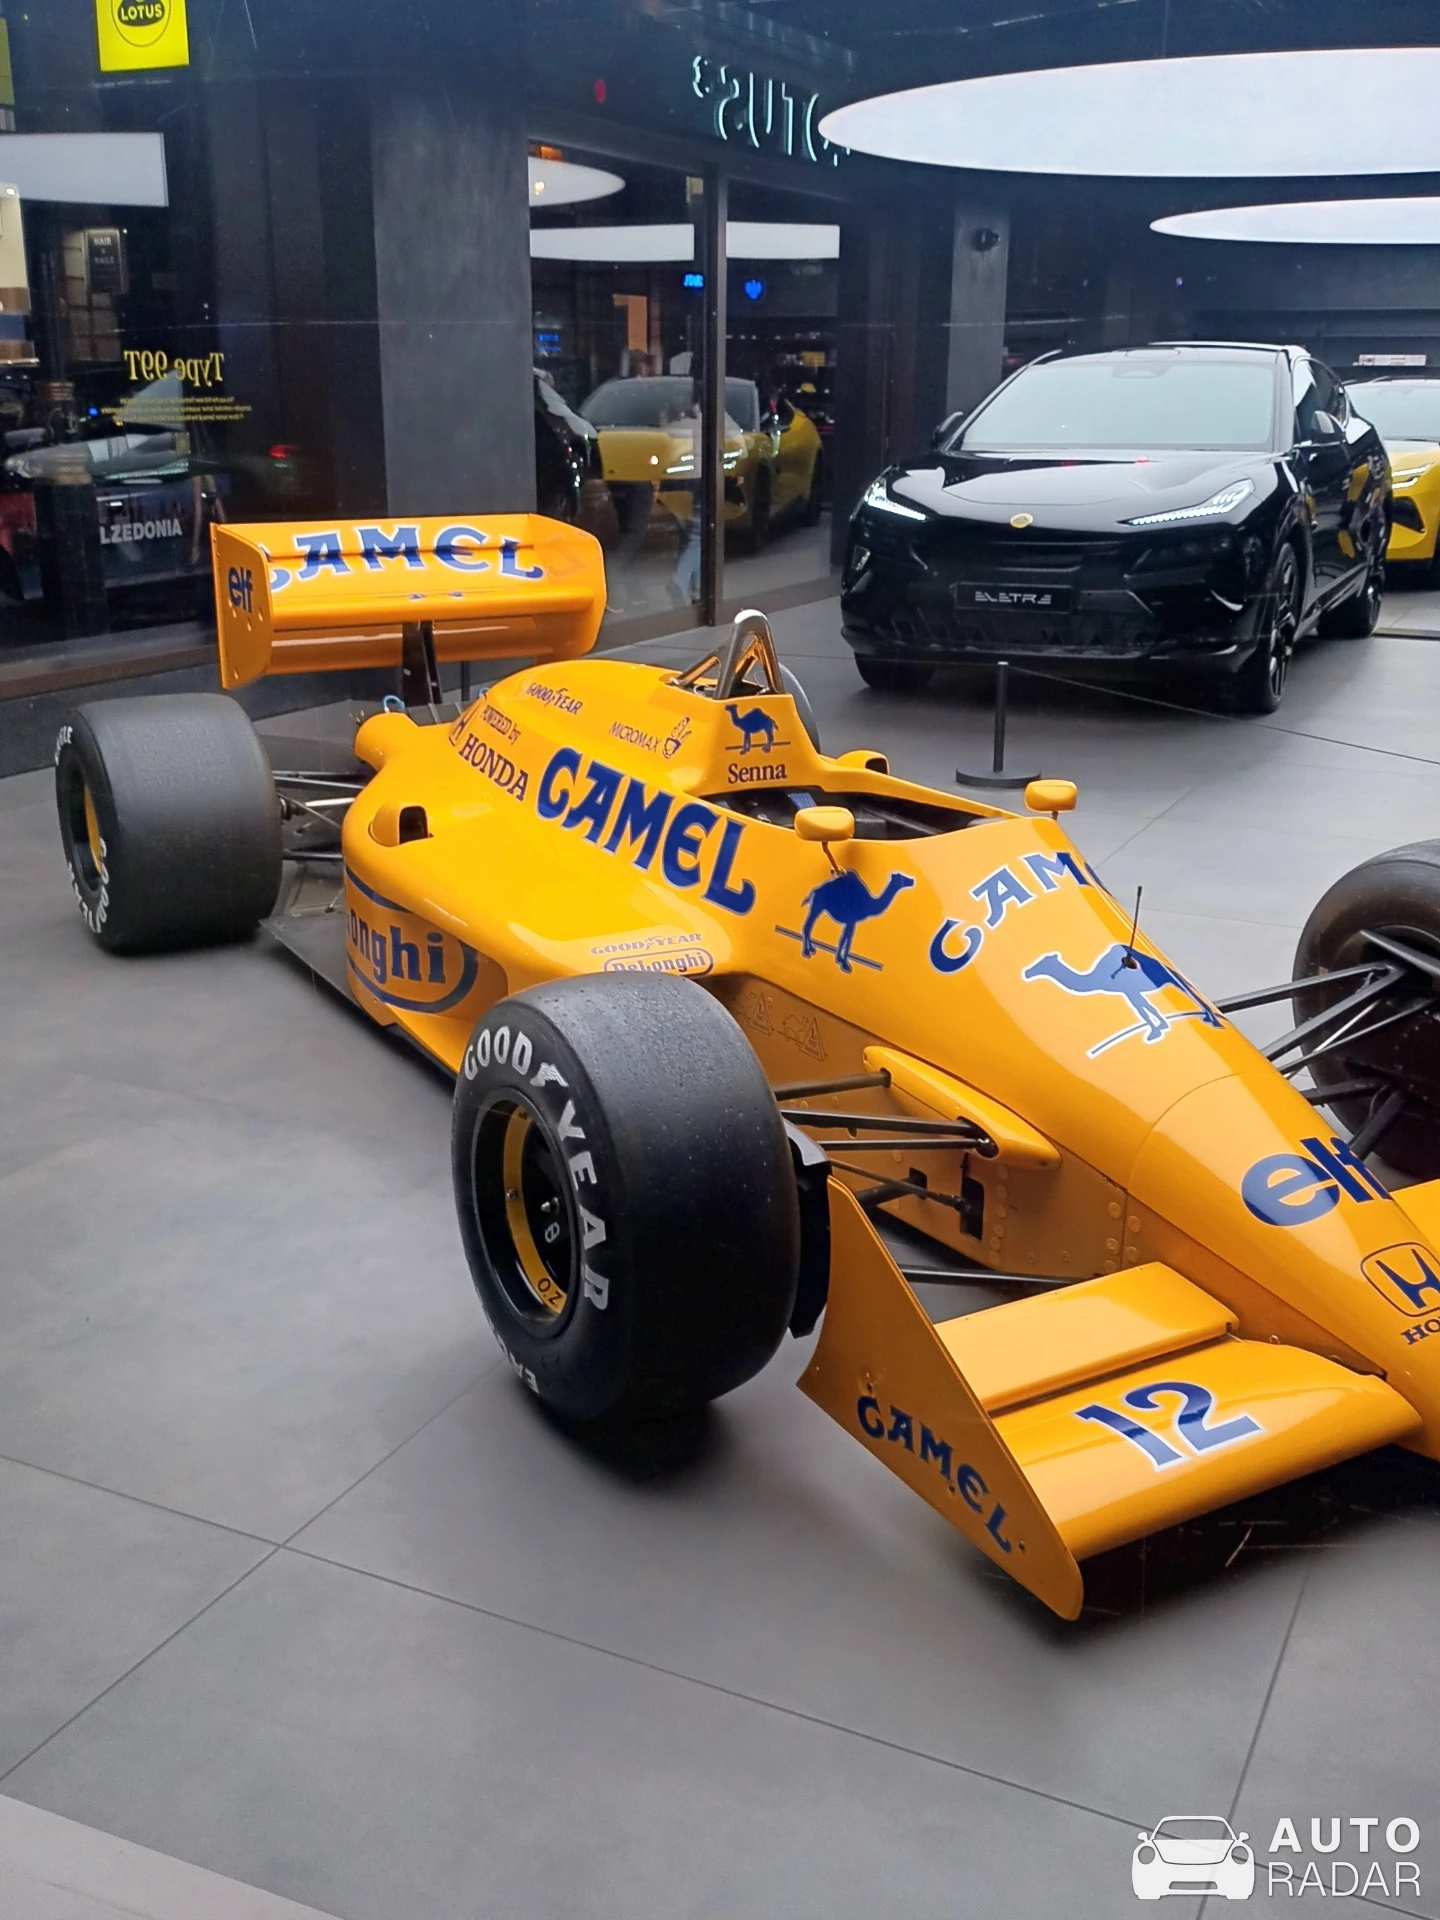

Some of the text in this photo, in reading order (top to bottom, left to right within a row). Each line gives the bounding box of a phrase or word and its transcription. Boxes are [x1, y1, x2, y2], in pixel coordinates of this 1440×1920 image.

[121, 3, 163, 21] LOTUS
[100, 518, 183, 545] LZEDONIA
[228, 565, 254, 613] elf
[483, 704, 513, 736] POWERED
[608, 720, 662, 754] MICROMAX
[458, 732, 529, 802] HONDA
[727, 763, 788, 785] Senna
[535, 746, 757, 917] CAMEL
[348, 907, 446, 985] onghi
[928, 851, 1118, 973] CAM
[1241, 1137, 1392, 1227] elf
[1072, 1381, 1263, 1471] 12
[857, 1396, 1013, 1554] CAMEL
